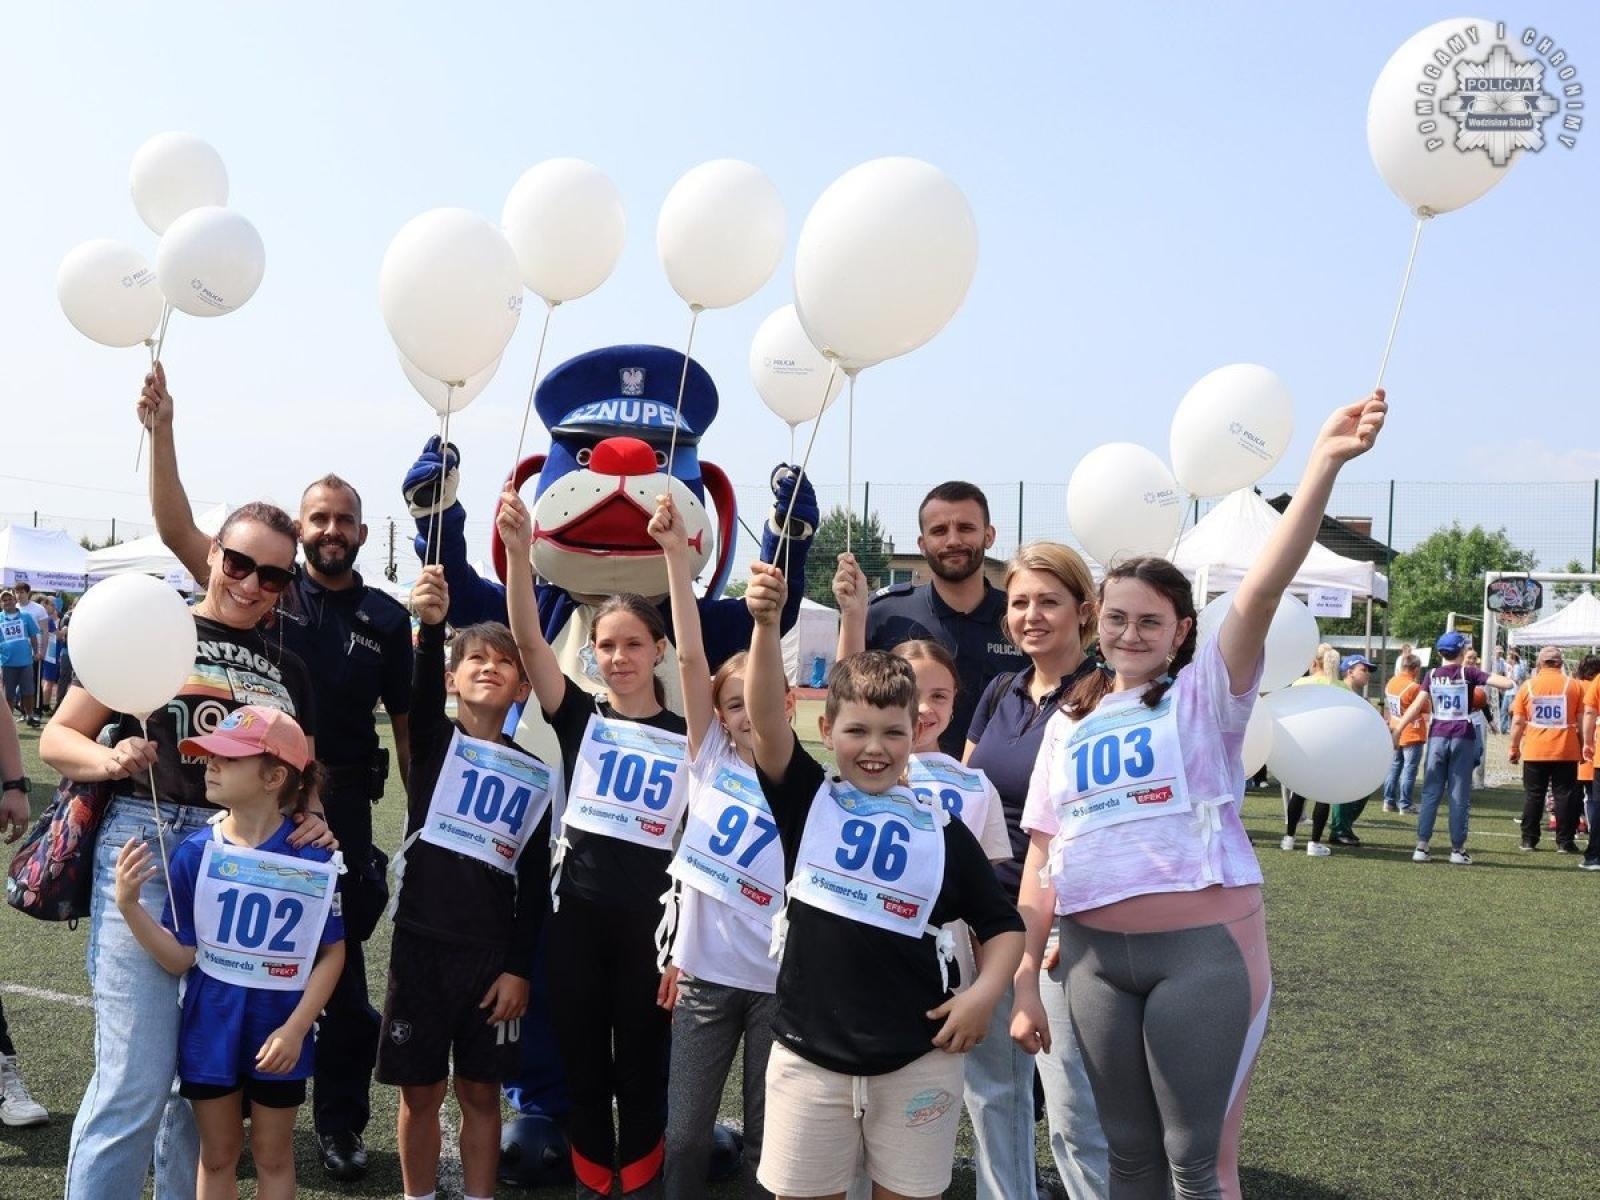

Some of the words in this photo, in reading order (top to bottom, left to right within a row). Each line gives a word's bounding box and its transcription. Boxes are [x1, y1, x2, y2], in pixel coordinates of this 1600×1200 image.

[351, 631, 381, 654] POLICJA
[1535, 705, 1561, 719] 206
[596, 750, 677, 810] 105
[1072, 727, 1154, 792] 103
[457, 769, 531, 836] 104
[1138, 791, 1168, 803] EFEKT
[708, 805, 778, 868] 97
[836, 819, 910, 882] 96
[217, 888, 303, 952] 102
[885, 902, 914, 917] EFEKT
[271, 967, 295, 977] EFEKT
